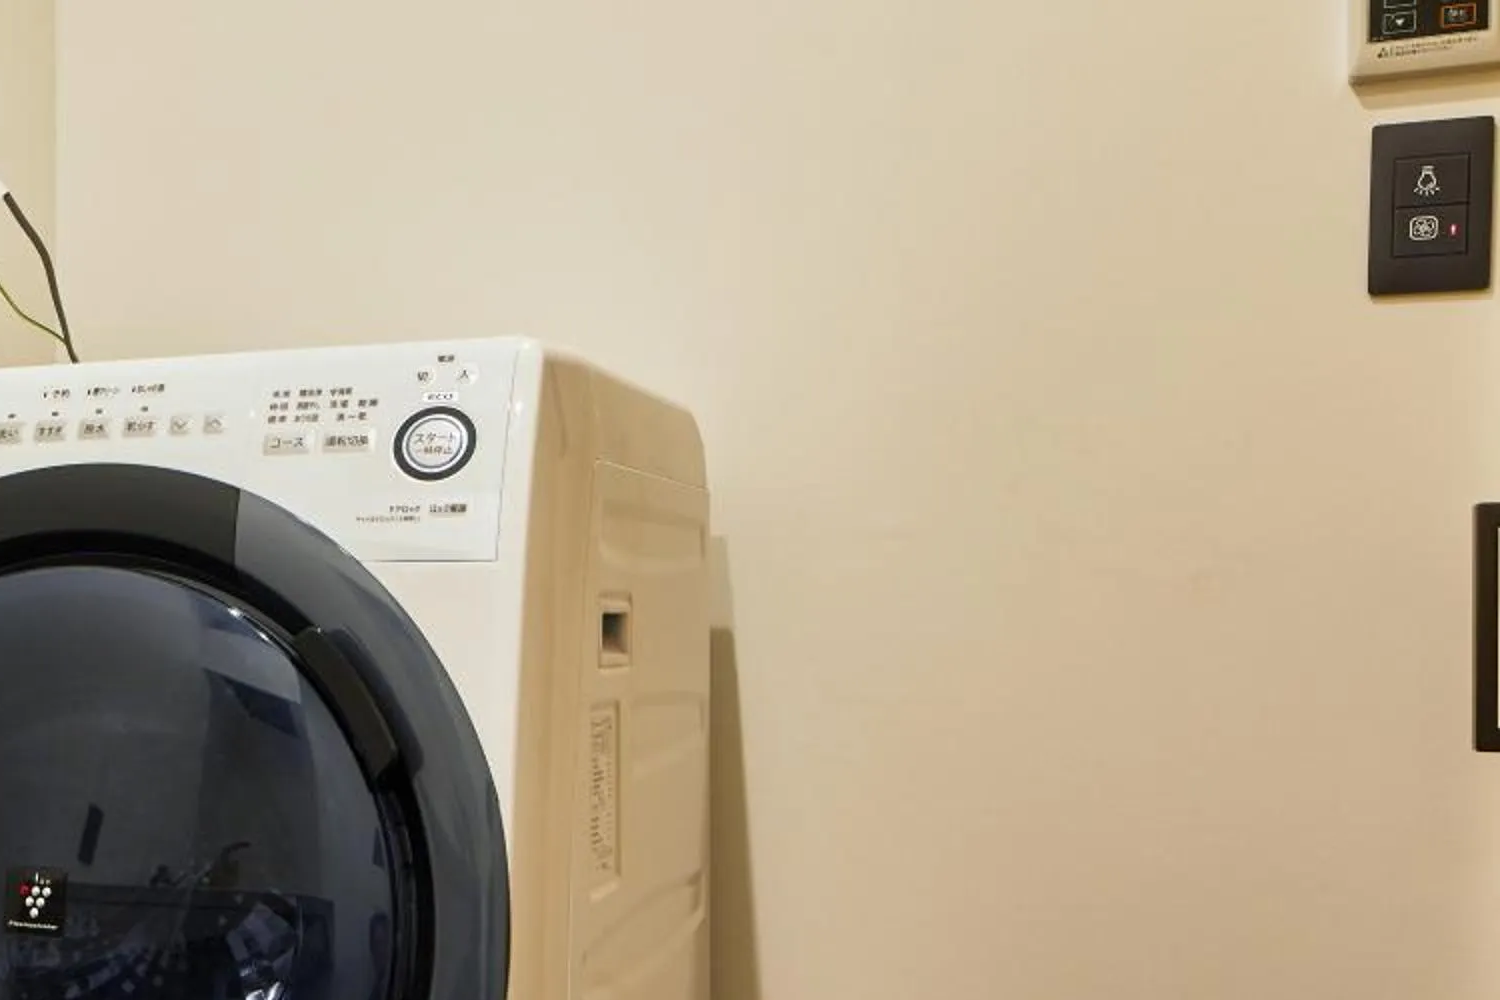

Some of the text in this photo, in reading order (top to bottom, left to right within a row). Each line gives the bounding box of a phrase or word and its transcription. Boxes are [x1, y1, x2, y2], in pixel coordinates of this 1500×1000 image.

[269, 436, 304, 449] コース
[414, 431, 458, 444] スタート
